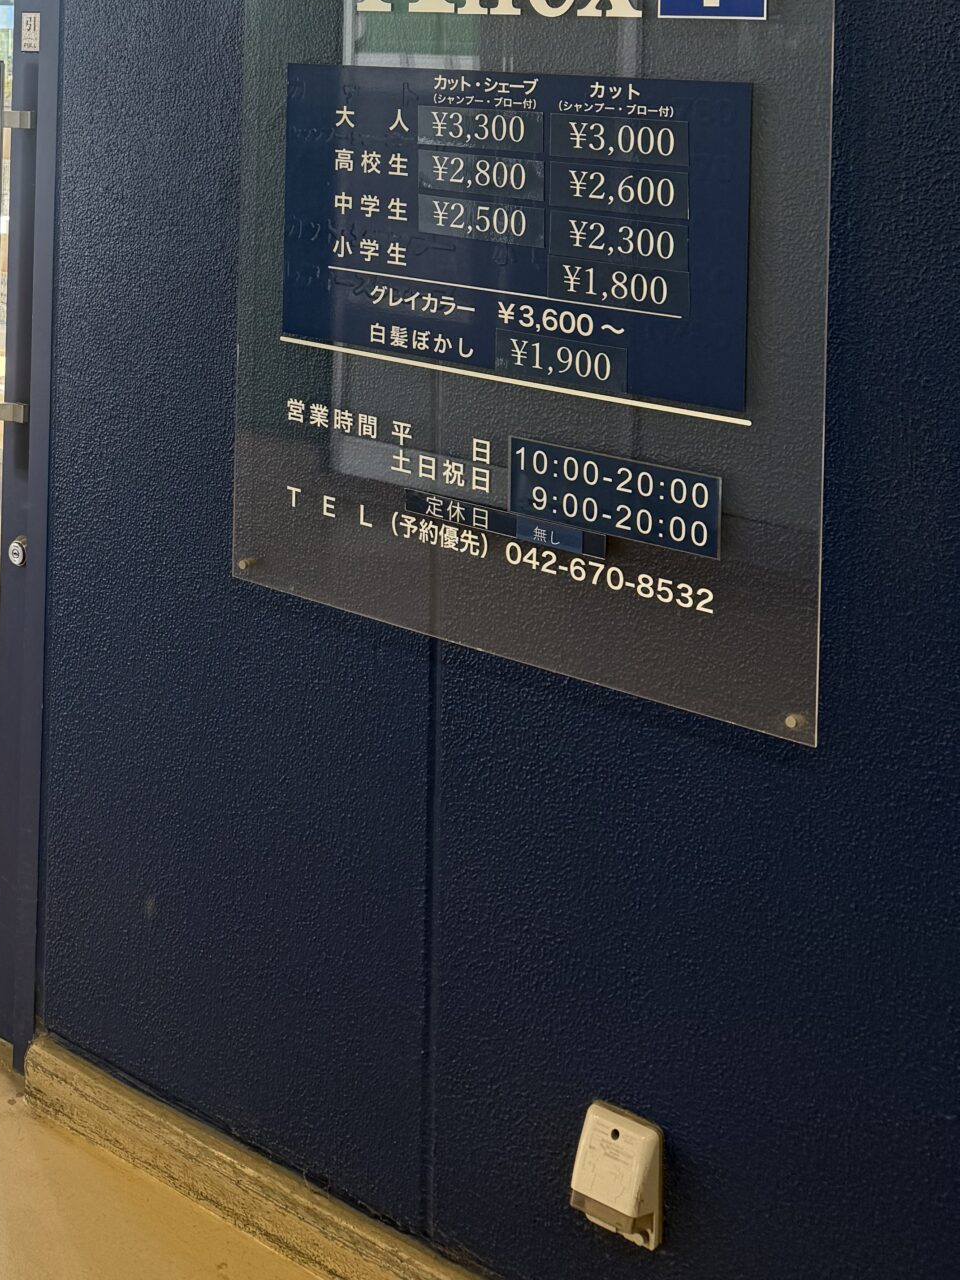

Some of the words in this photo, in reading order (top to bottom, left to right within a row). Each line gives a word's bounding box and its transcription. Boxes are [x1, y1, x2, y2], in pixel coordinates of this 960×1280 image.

[433, 74, 539, 95] カット・シェーブ
[589, 81, 641, 100] カット
[431, 111, 525, 143] ¥3,300
[568, 122, 675, 158] ¥3,000
[334, 148, 409, 177] 高校生
[432, 155, 526, 190] ¥2,800
[568, 169, 675, 207] ¥2,600
[333, 192, 408, 221] 中学生
[432, 200, 527, 237] ¥2,500
[568, 220, 675, 261] ¥2,300
[332, 236, 407, 266] 小学生
[562, 264, 668, 306] ¥1,800
[370, 284, 476, 317] グレイカラー
[369, 323, 475, 359] 白髪ぼかし
[510, 338, 611, 383] ¥1,900
[286, 398, 378, 440] 営業時間
[515, 446, 710, 510] 10:00-20:00
[391, 450, 491, 494] 土日祝日
[531, 486, 709, 549] 9:00-20:00
[425, 495, 490, 530] 定休日
[532, 525, 561, 547] 無し
[391, 515, 489, 559] (予約優先)
[505, 541, 715, 615] 042-670-8532
